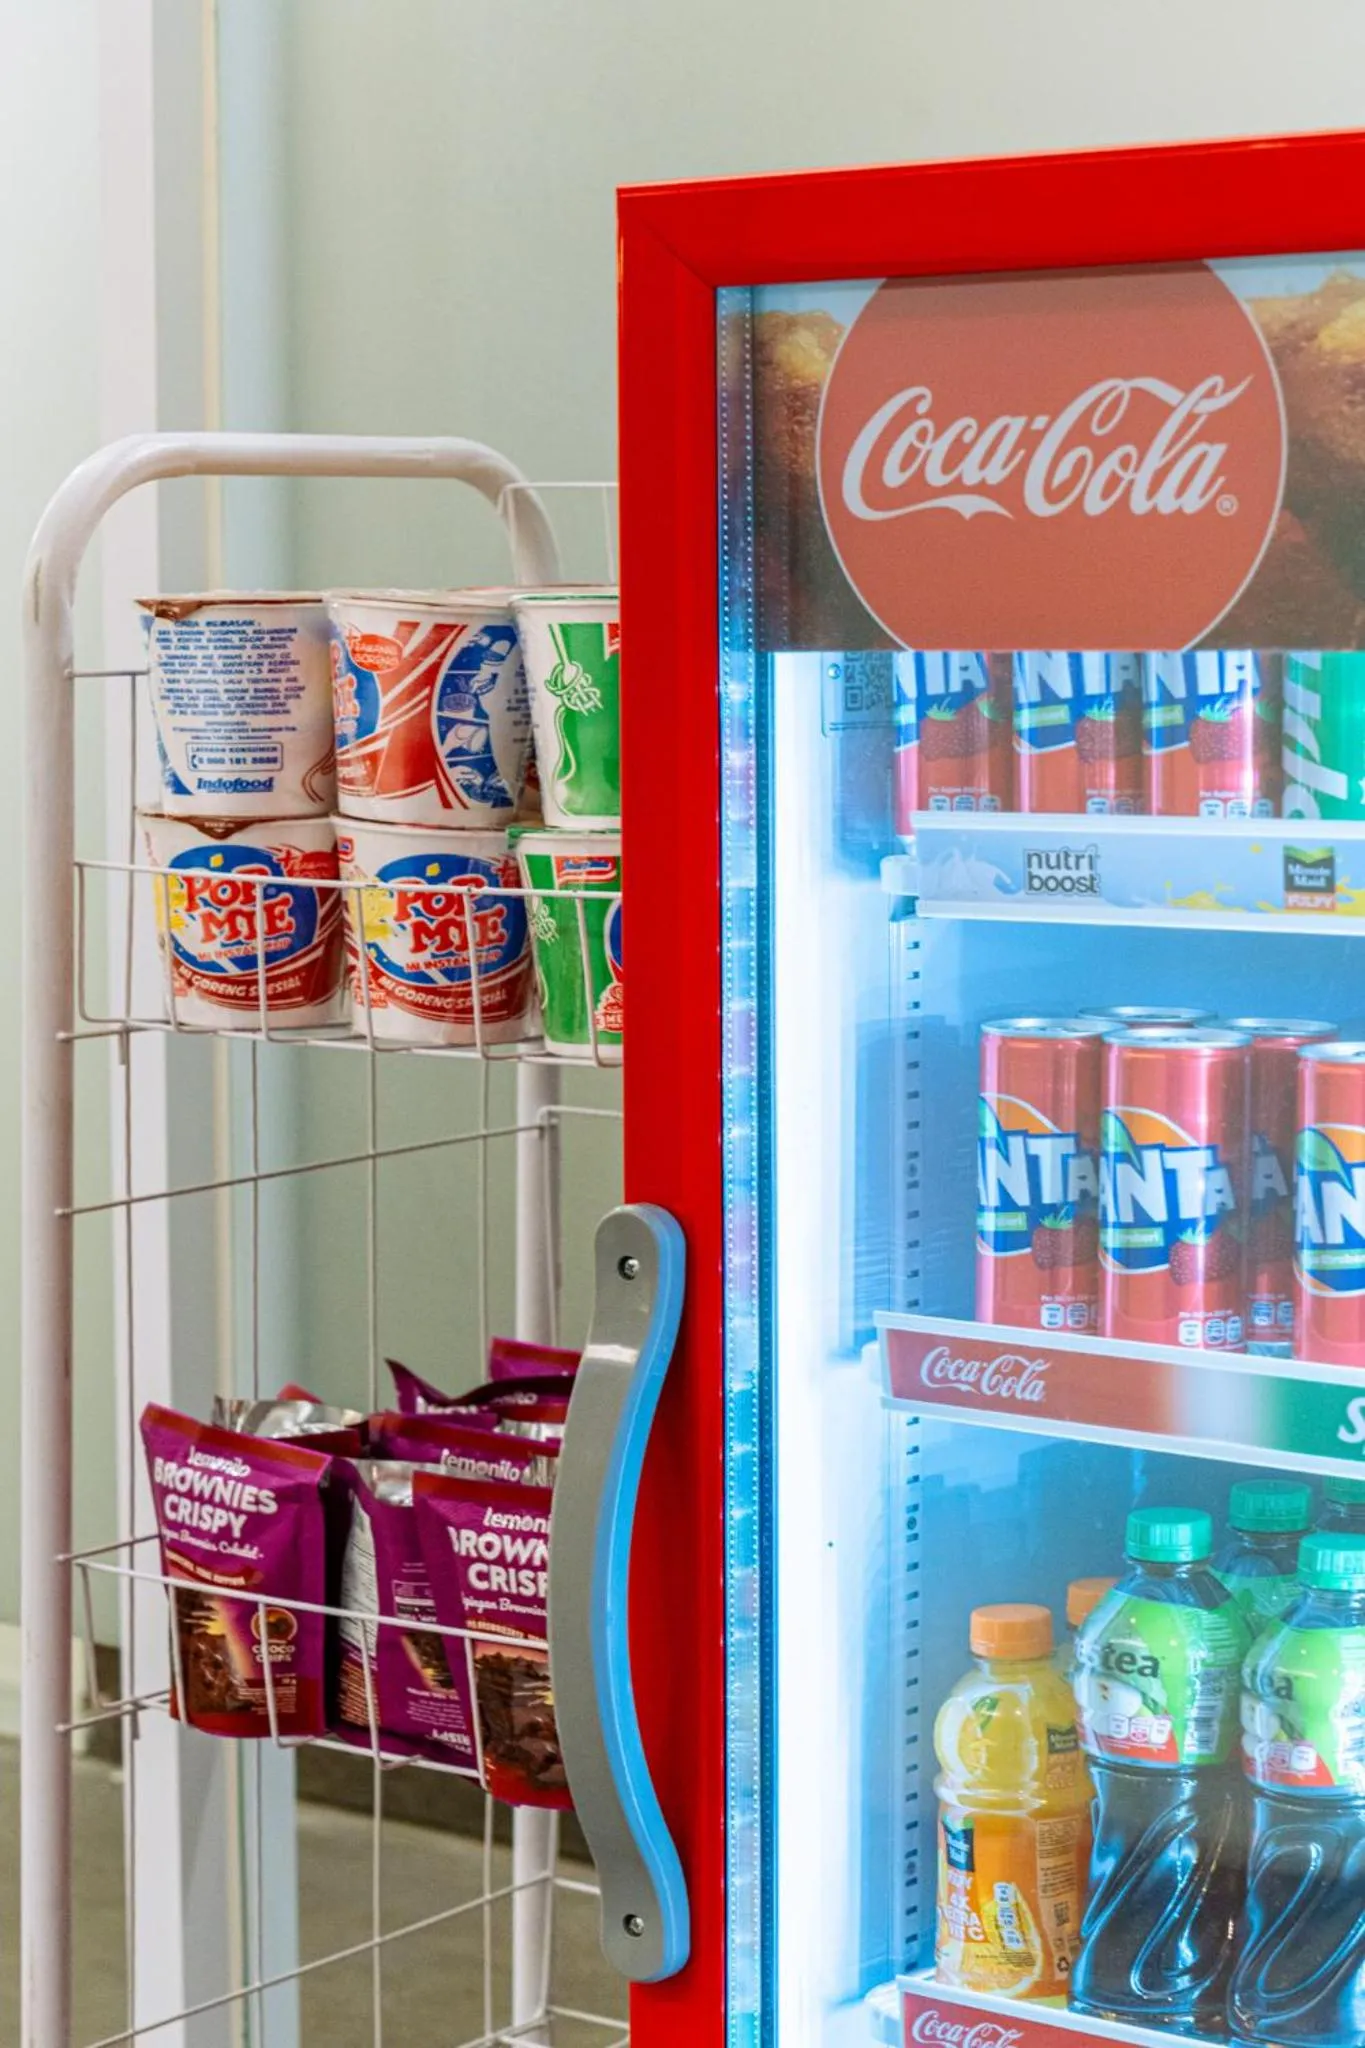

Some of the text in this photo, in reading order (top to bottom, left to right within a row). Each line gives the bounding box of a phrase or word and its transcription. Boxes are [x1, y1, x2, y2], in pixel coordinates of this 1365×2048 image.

[842, 374, 1254, 521] Coca-Cola
[196, 776, 274, 790] Indofood
[1026, 850, 1095, 870] nutri
[1027, 871, 1098, 894] boost
[200, 892, 296, 944] MIE
[410, 904, 508, 953] MIE
[192, 973, 248, 997] GORENG
[249, 975, 302, 997] SESIAL
[394, 984, 455, 1009] GORENG
[456, 989, 508, 1009] SPSIAL
[919, 1346, 1052, 1402] Coca-Cola
[440, 1448, 521, 1482] lemonilo
[153, 1456, 279, 1514] BROWNIES
[164, 1493, 248, 1539] CRISPY
[251, 1644, 296, 1654] COCO
